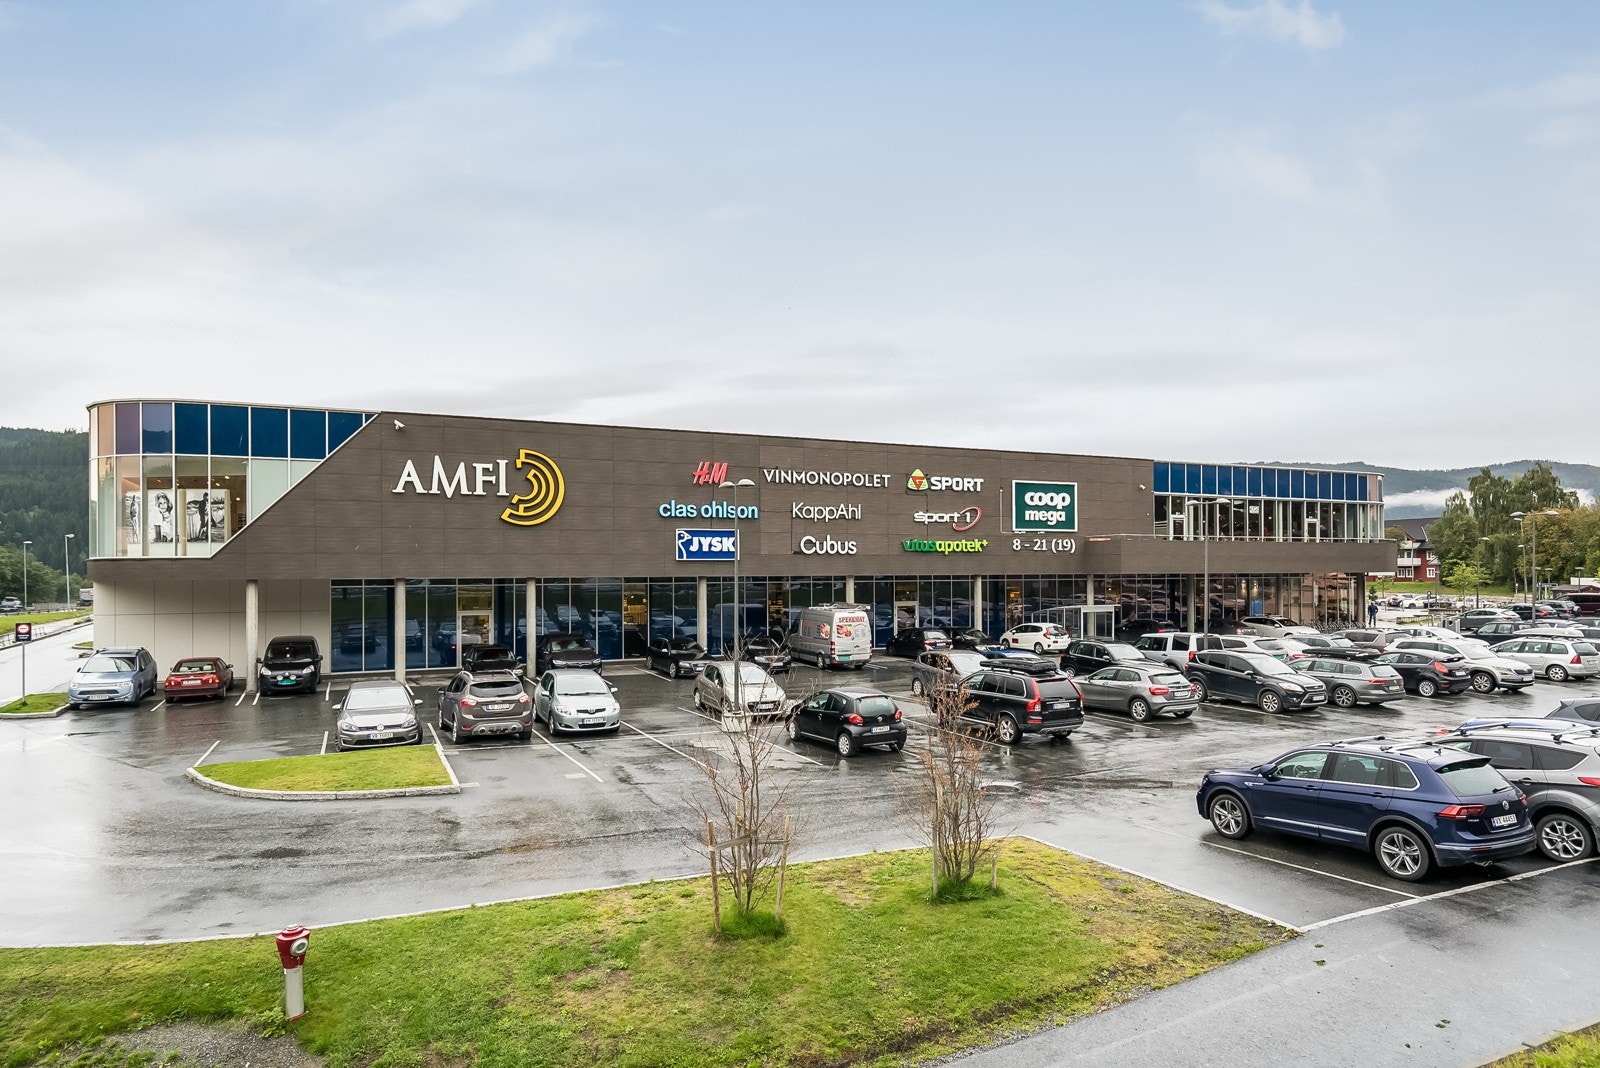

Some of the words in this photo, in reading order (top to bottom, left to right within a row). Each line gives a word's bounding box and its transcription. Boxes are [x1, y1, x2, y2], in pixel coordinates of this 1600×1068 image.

[392, 455, 511, 499] AMFI
[692, 461, 729, 486] H&M
[763, 469, 890, 488] VINMONOPOLET
[930, 476, 985, 492] SPORT
[658, 499, 698, 519] clas
[700, 500, 759, 519] ohlson
[1024, 491, 1071, 510] coop
[792, 501, 862, 523] KappAhl
[913, 511, 961, 525] sport
[1024, 509, 1066, 526] mega
[689, 536, 736, 553] JYSK
[800, 535, 857, 555] Cubus
[1012, 538, 1021, 551] 8
[1033, 538, 1047, 551] 21
[1051, 538, 1076, 554] (19)
